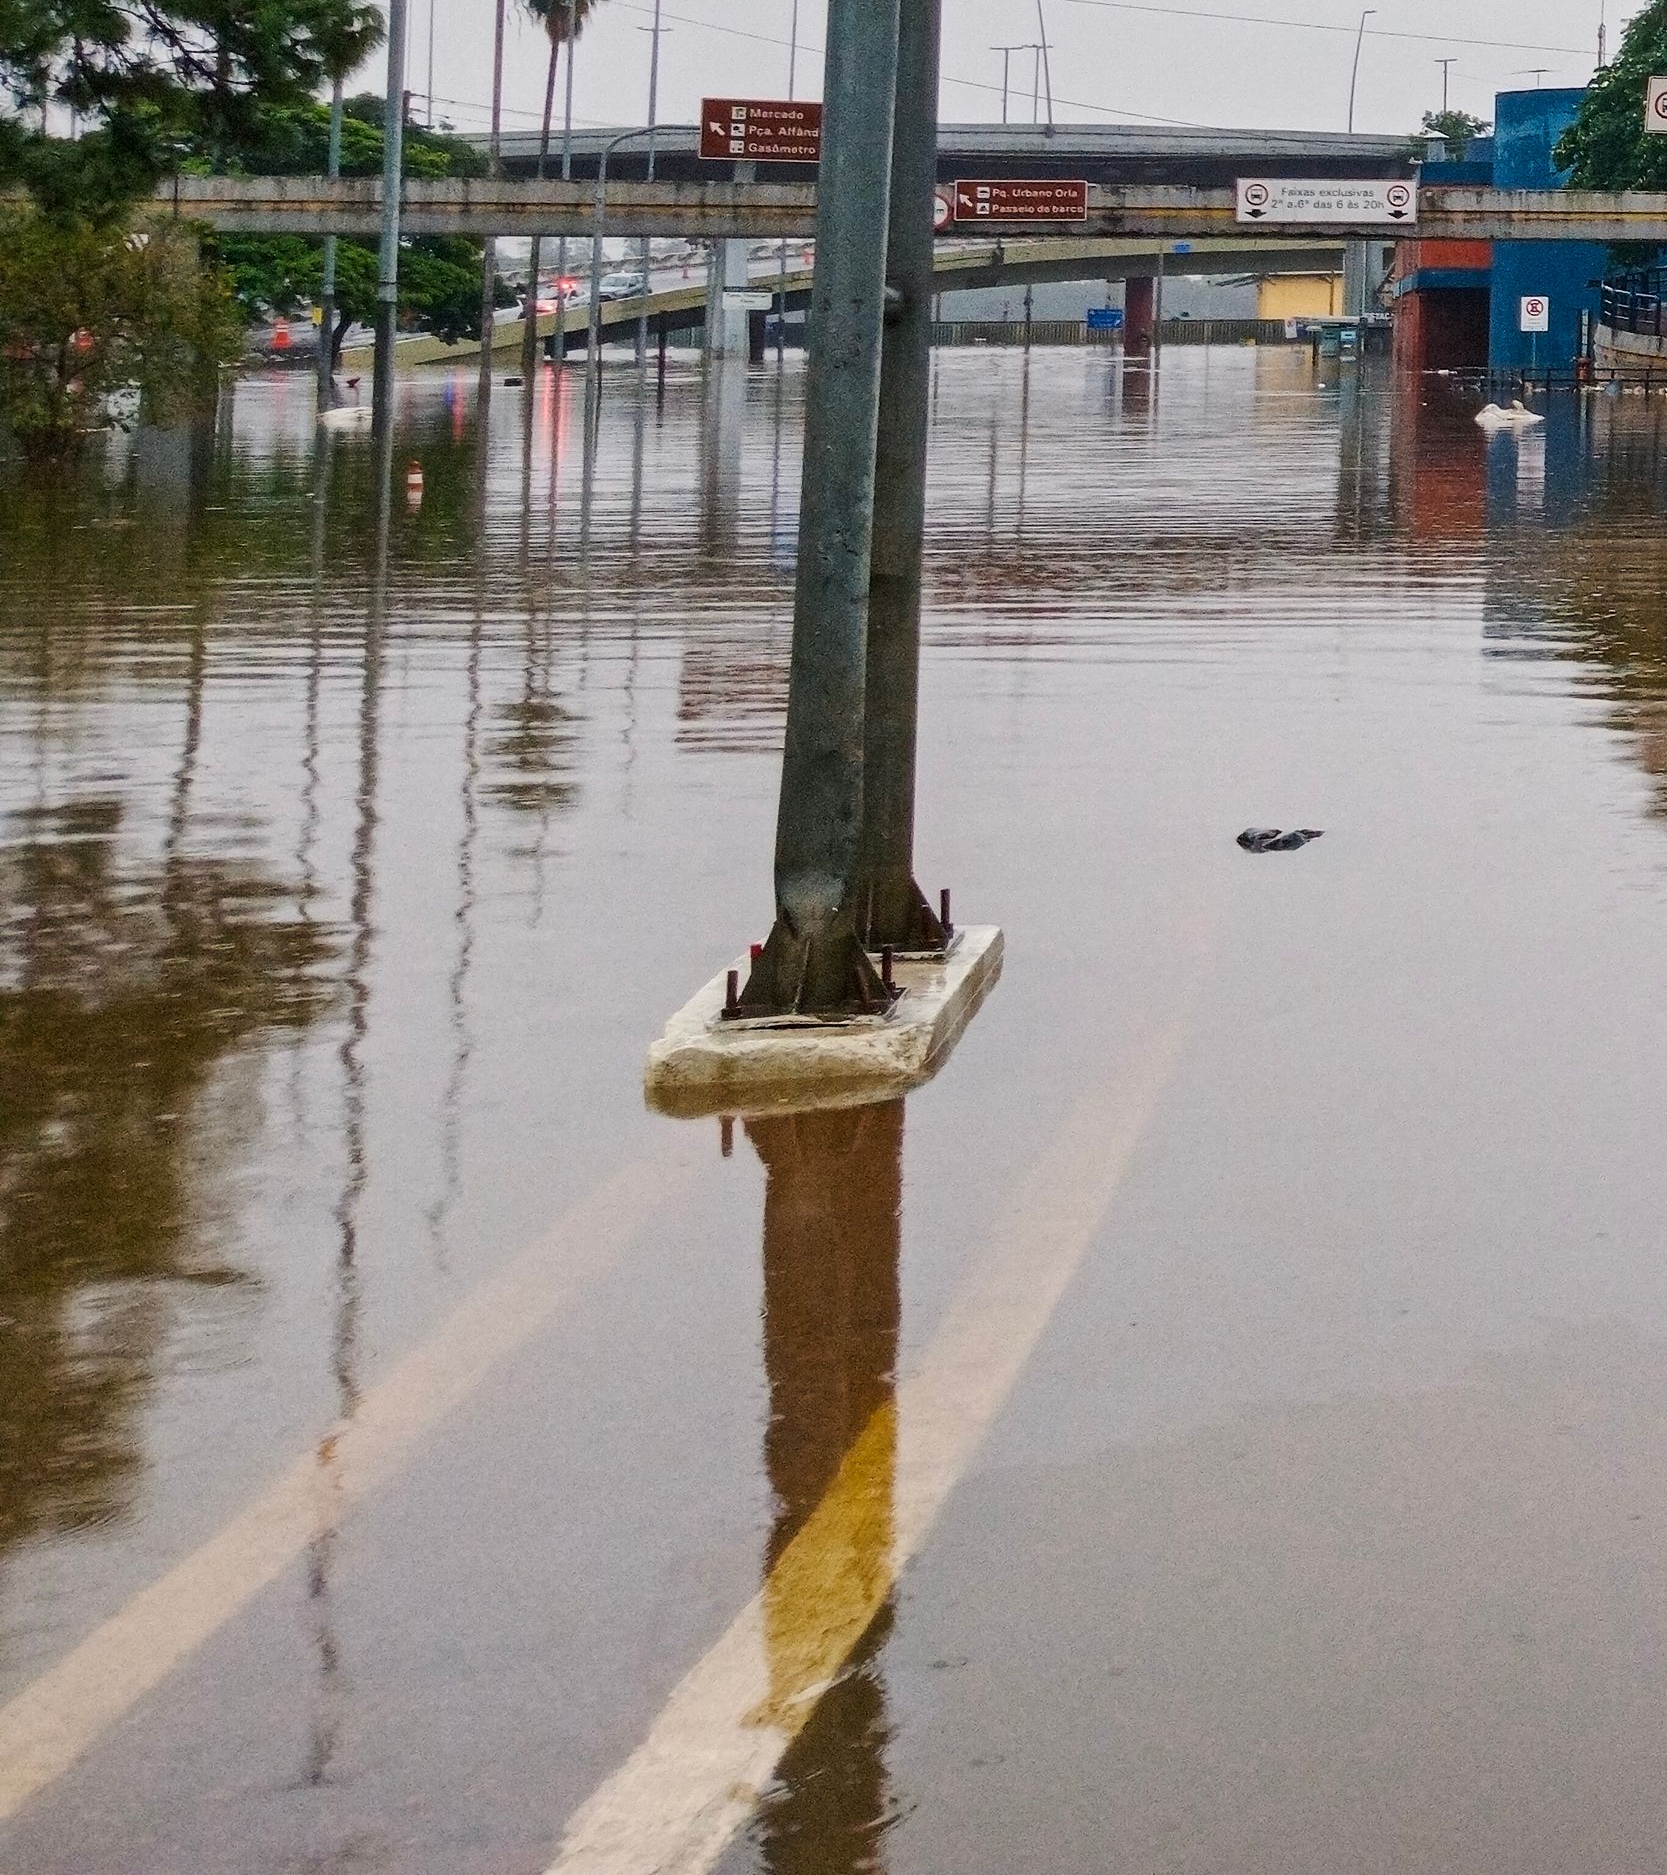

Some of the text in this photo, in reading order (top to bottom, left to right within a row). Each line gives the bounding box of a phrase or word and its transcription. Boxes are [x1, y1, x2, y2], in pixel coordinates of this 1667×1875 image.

[749, 108, 804, 120] Mercado
[778, 126, 819, 138] Alfând
[748, 142, 816, 154] Gasômetro
[1012, 188, 1053, 198] Urbano
[1055, 188, 1078, 198] Orla
[1281, 187, 1374, 197] Faixas exclusivas
[1052, 204, 1084, 213] barco
[1313, 199, 1332, 208] das
[1363, 199, 1385, 209] 20h
